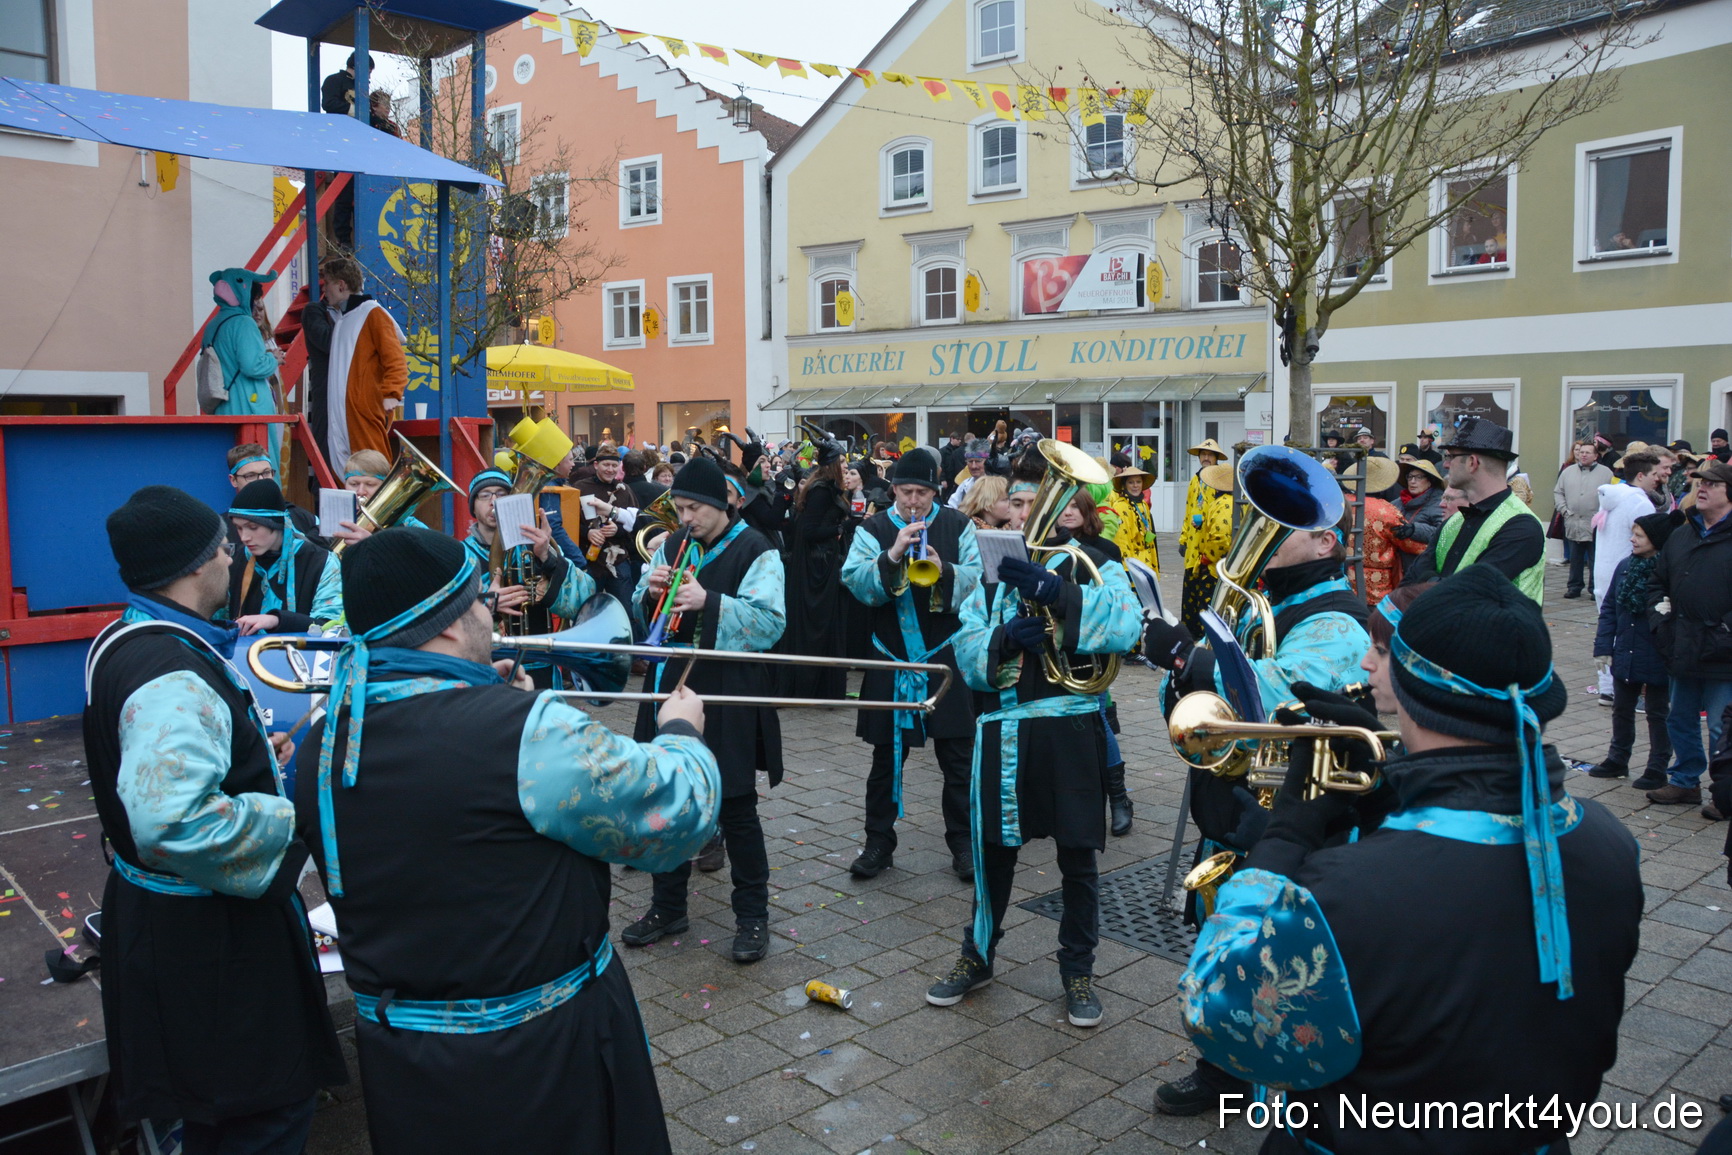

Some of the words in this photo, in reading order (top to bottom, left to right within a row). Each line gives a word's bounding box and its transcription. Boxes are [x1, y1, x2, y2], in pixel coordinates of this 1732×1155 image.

[1117, 296, 1134, 304] 2015
[802, 350, 905, 376] BÄCKEREI
[929, 339, 1038, 376] STOLL
[1069, 334, 1247, 364] KONDITOREI
